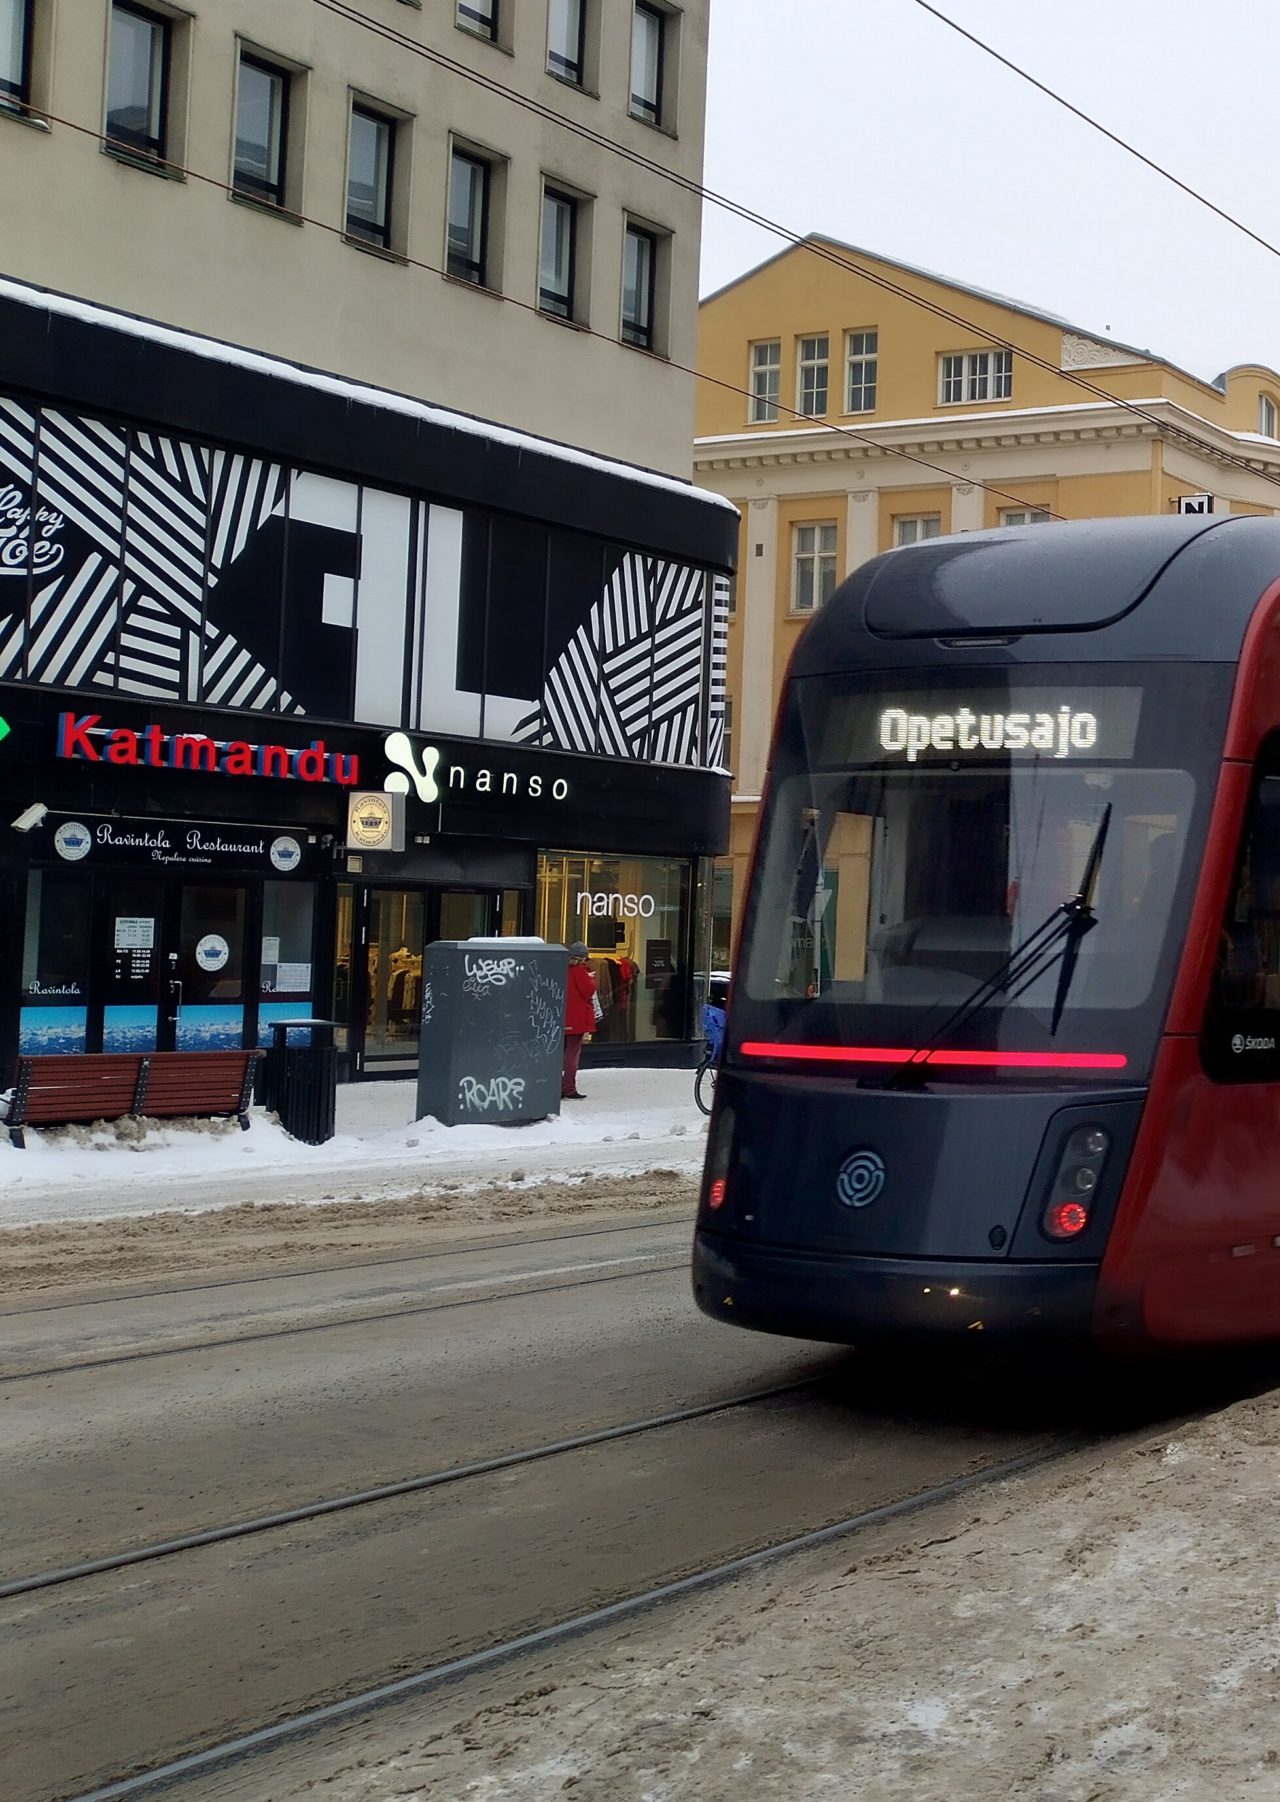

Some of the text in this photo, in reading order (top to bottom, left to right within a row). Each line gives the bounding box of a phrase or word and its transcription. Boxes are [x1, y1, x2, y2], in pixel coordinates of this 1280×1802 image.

[56, 712, 359, 785] Katmandu
[880, 705, 1097, 762] Opetusajo
[449, 765, 568, 800] nanso
[97, 823, 265, 853] Ravintola Restaurant
[576, 891, 655, 918] nanso
[29, 980, 81, 995] Ravintola
